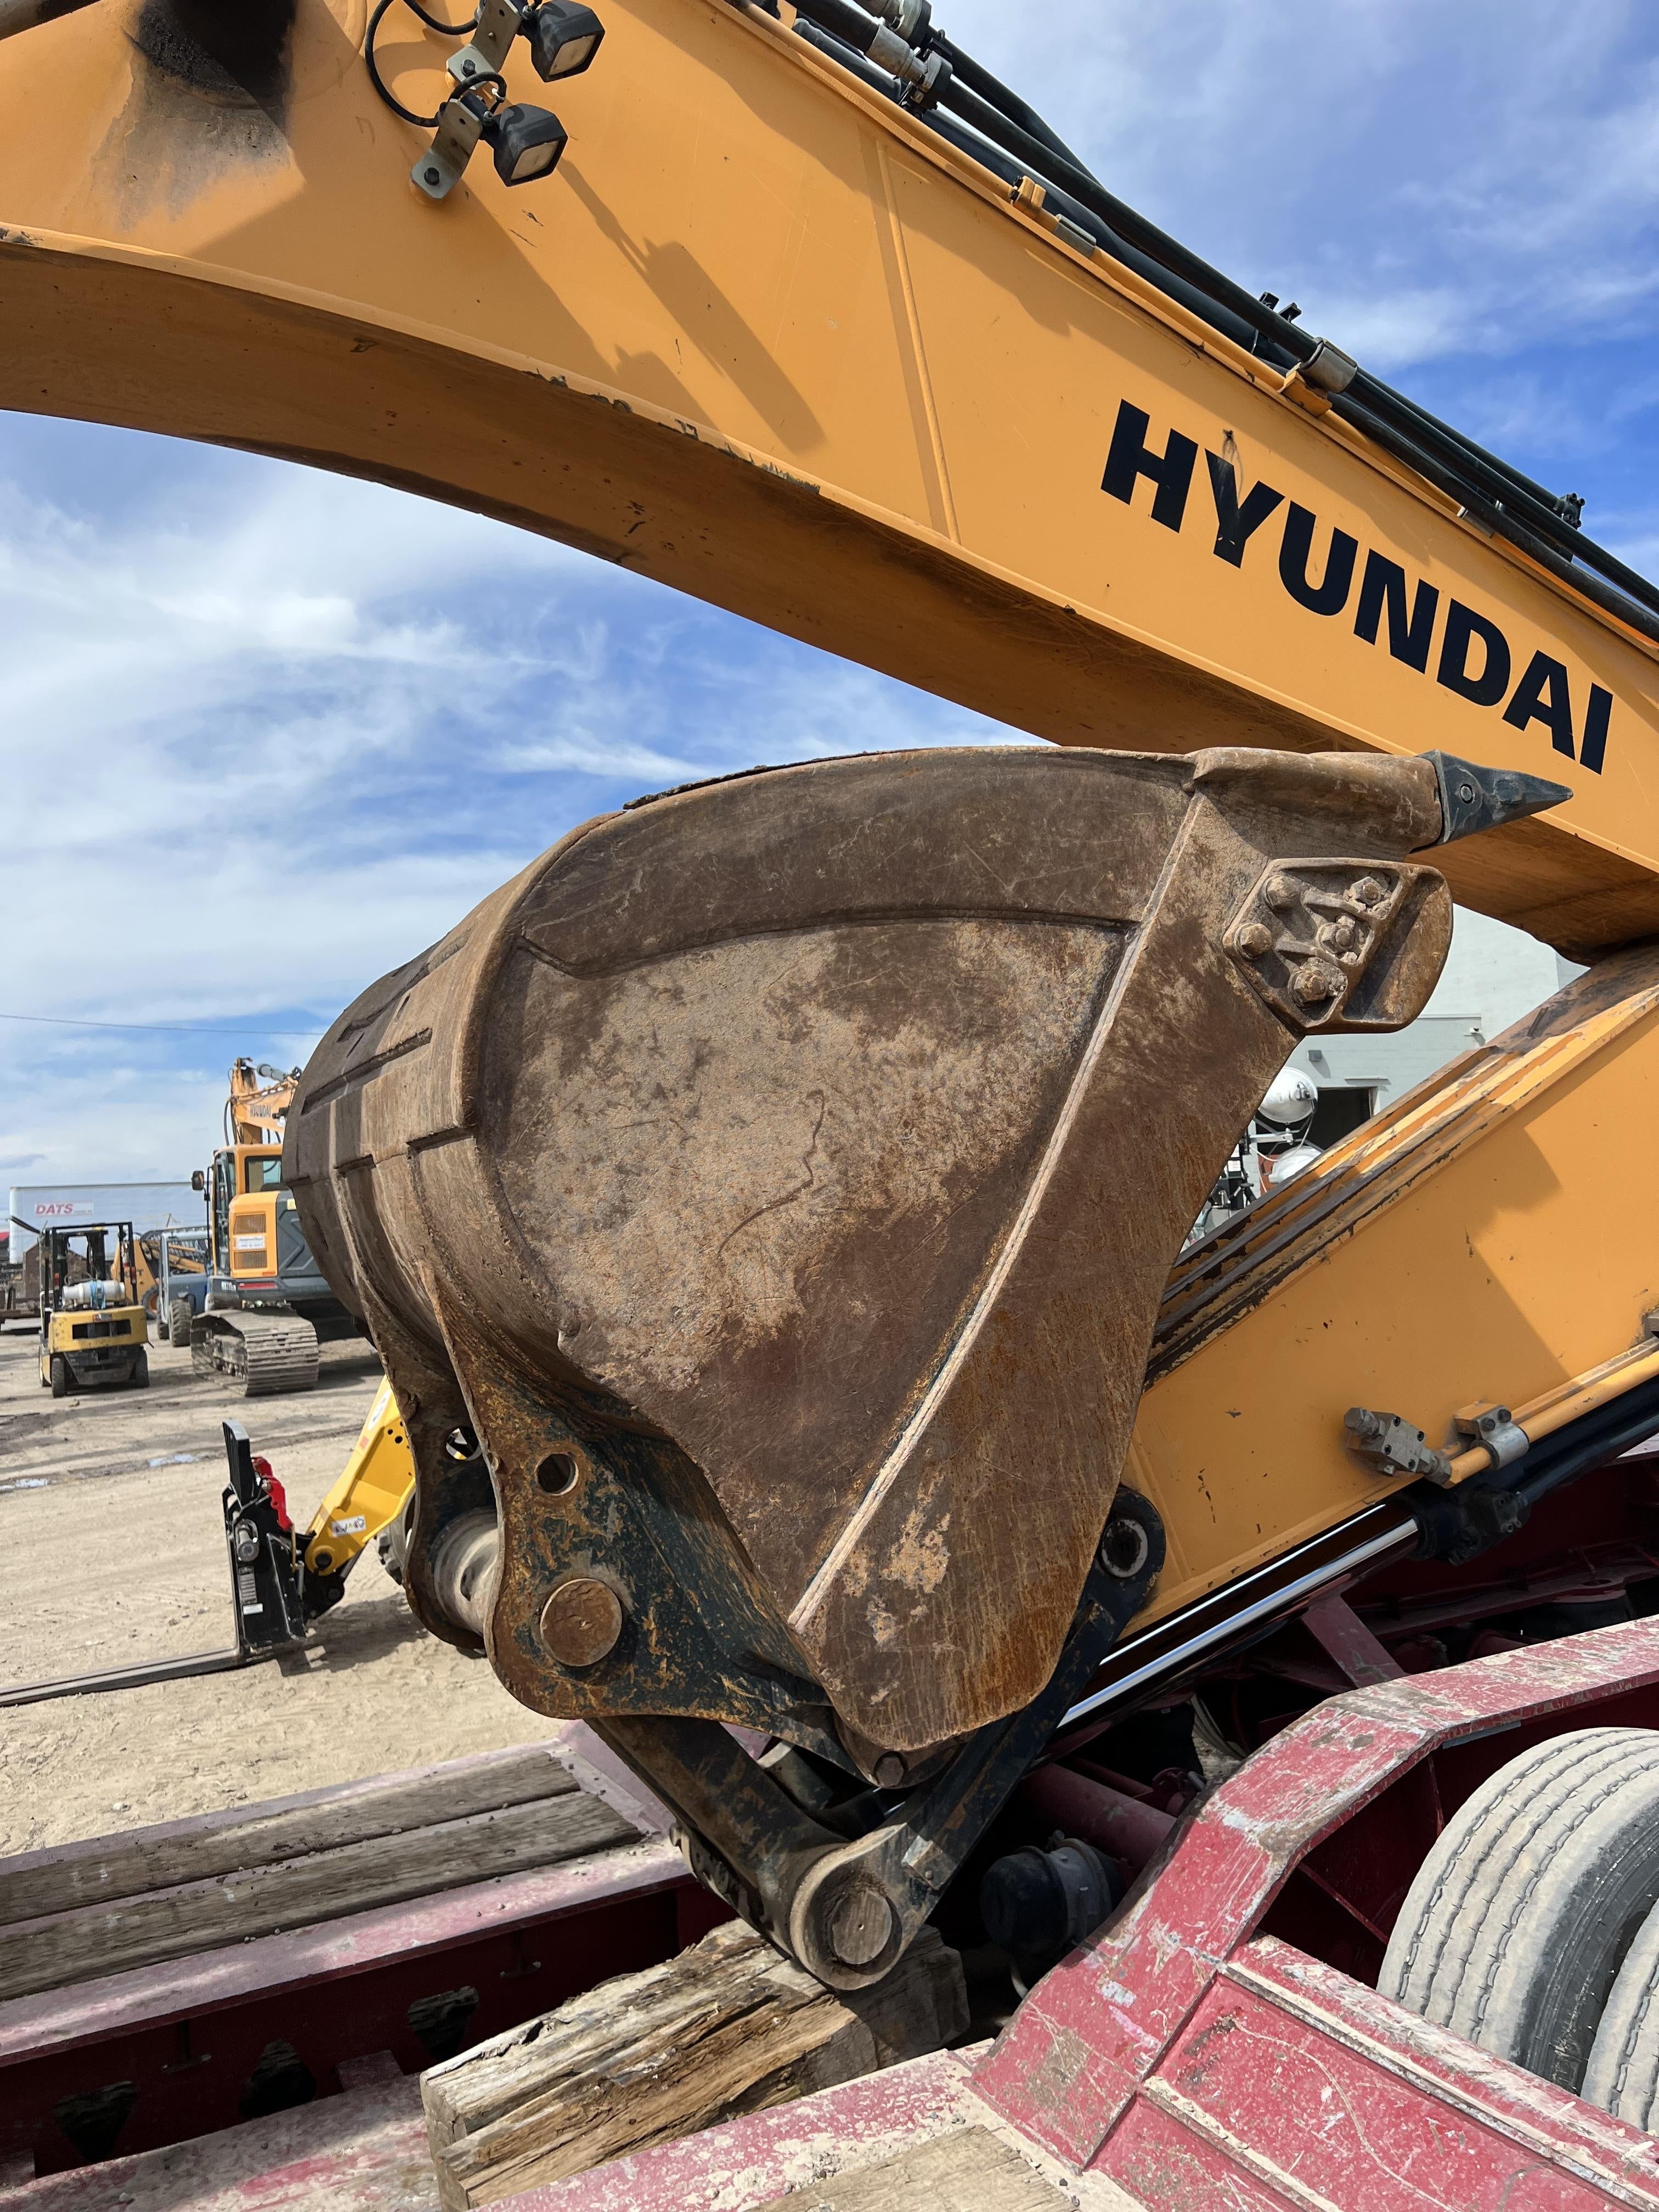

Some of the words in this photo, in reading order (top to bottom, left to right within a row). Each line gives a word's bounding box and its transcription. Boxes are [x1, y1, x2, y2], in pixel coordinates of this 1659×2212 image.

[1101, 399, 1613, 775] HYUNDAI
[250, 1104, 271, 1118] HYUNDAI
[36, 1204, 73, 1215] DATS
